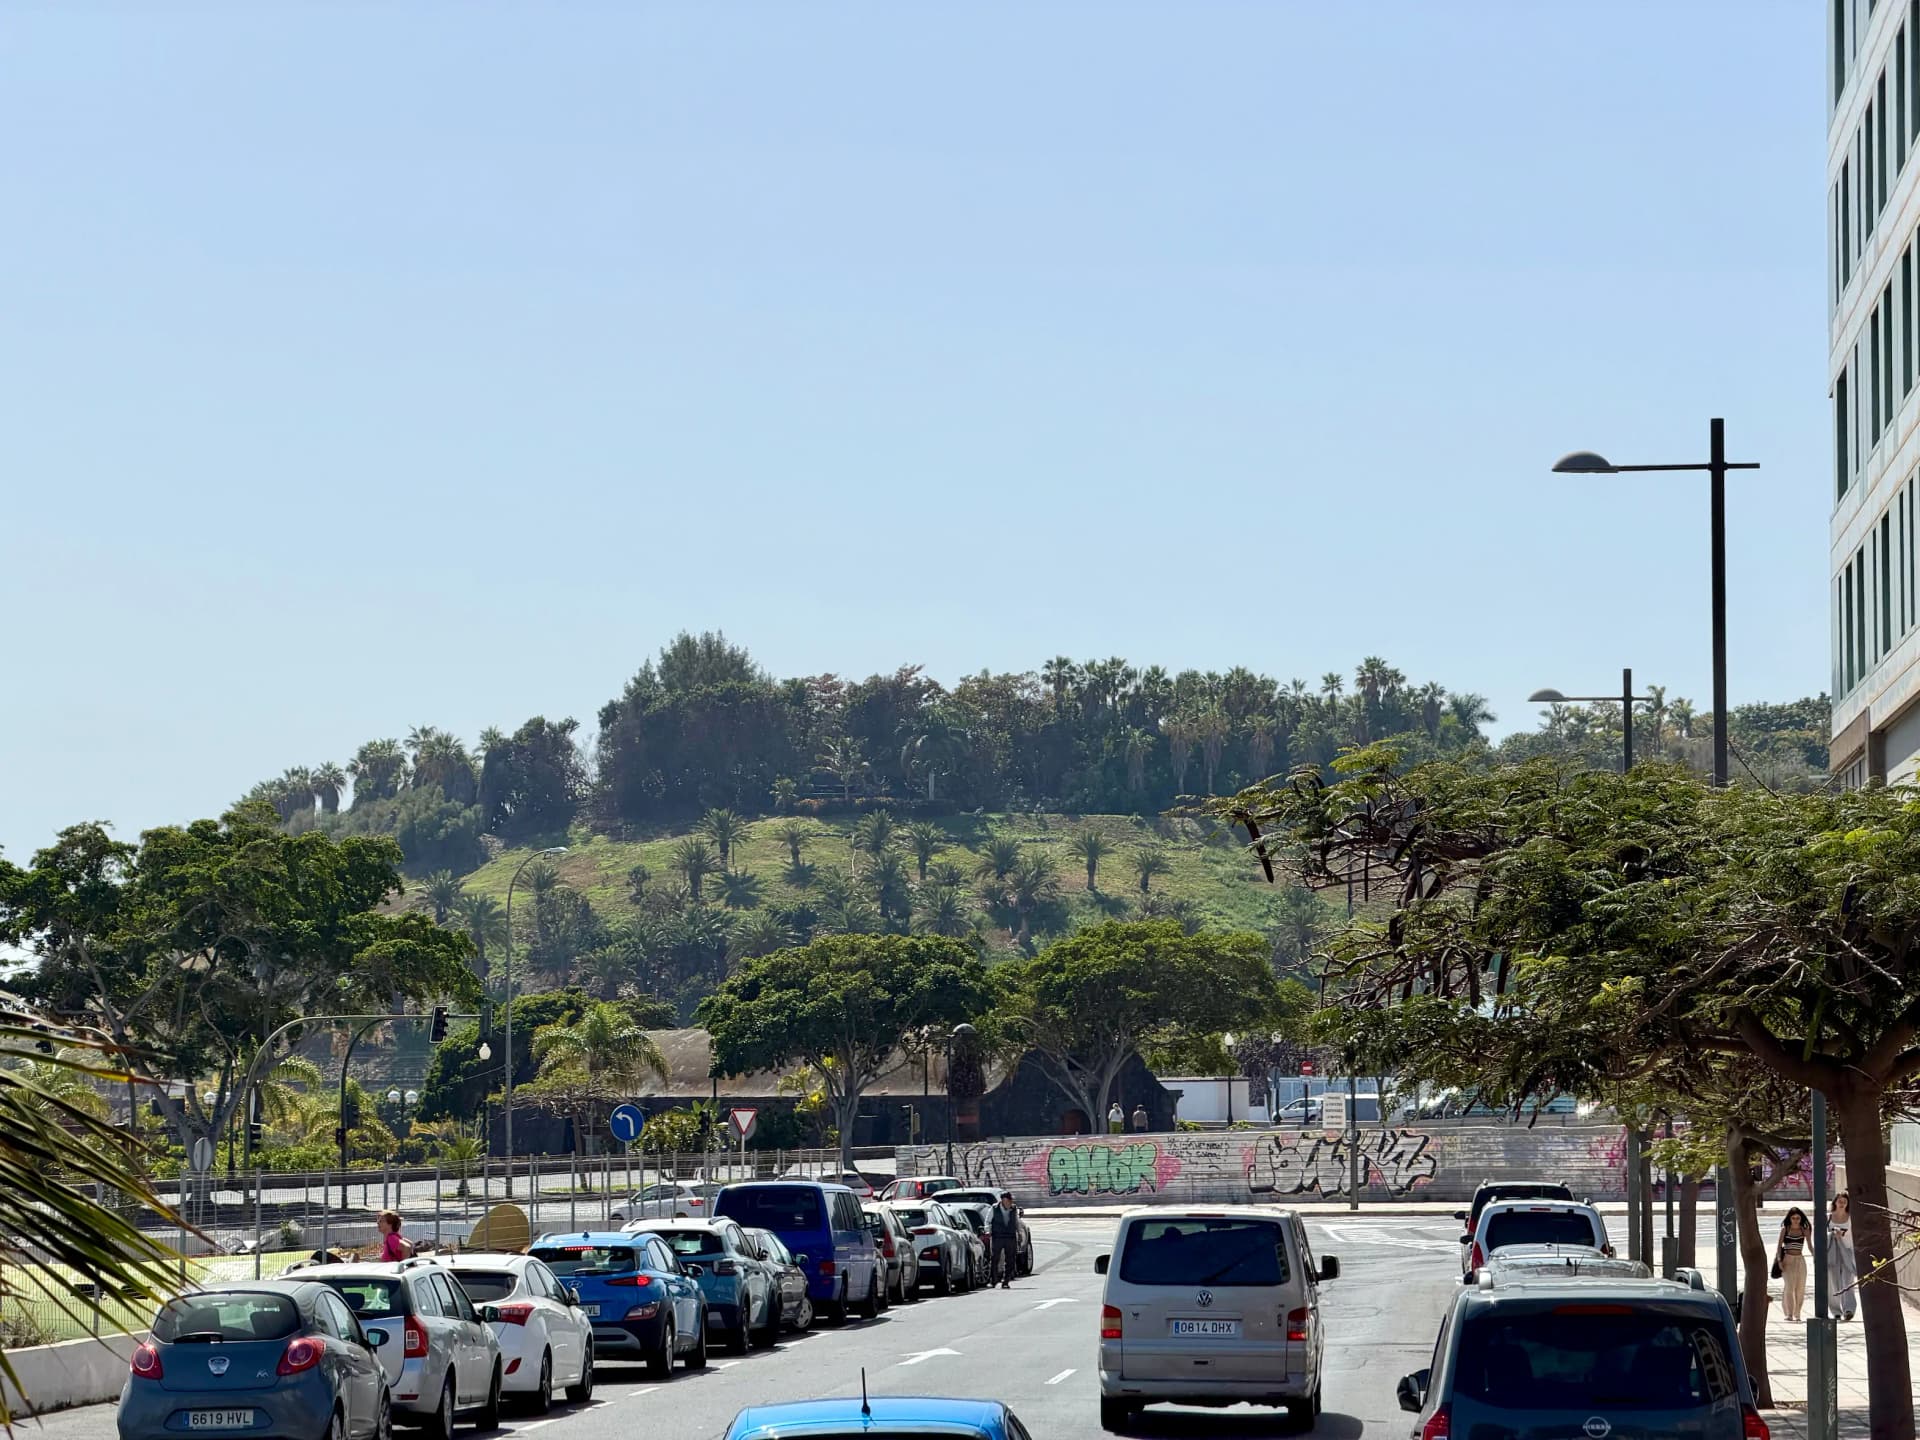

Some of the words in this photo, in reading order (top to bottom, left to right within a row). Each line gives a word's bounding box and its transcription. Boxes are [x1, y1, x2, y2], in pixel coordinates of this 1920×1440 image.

[1180, 1321, 1208, 1334] 0814
[1211, 1322, 1233, 1334] DHX
[192, 1412, 223, 1426] 6619
[227, 1412, 250, 1425] HVL
